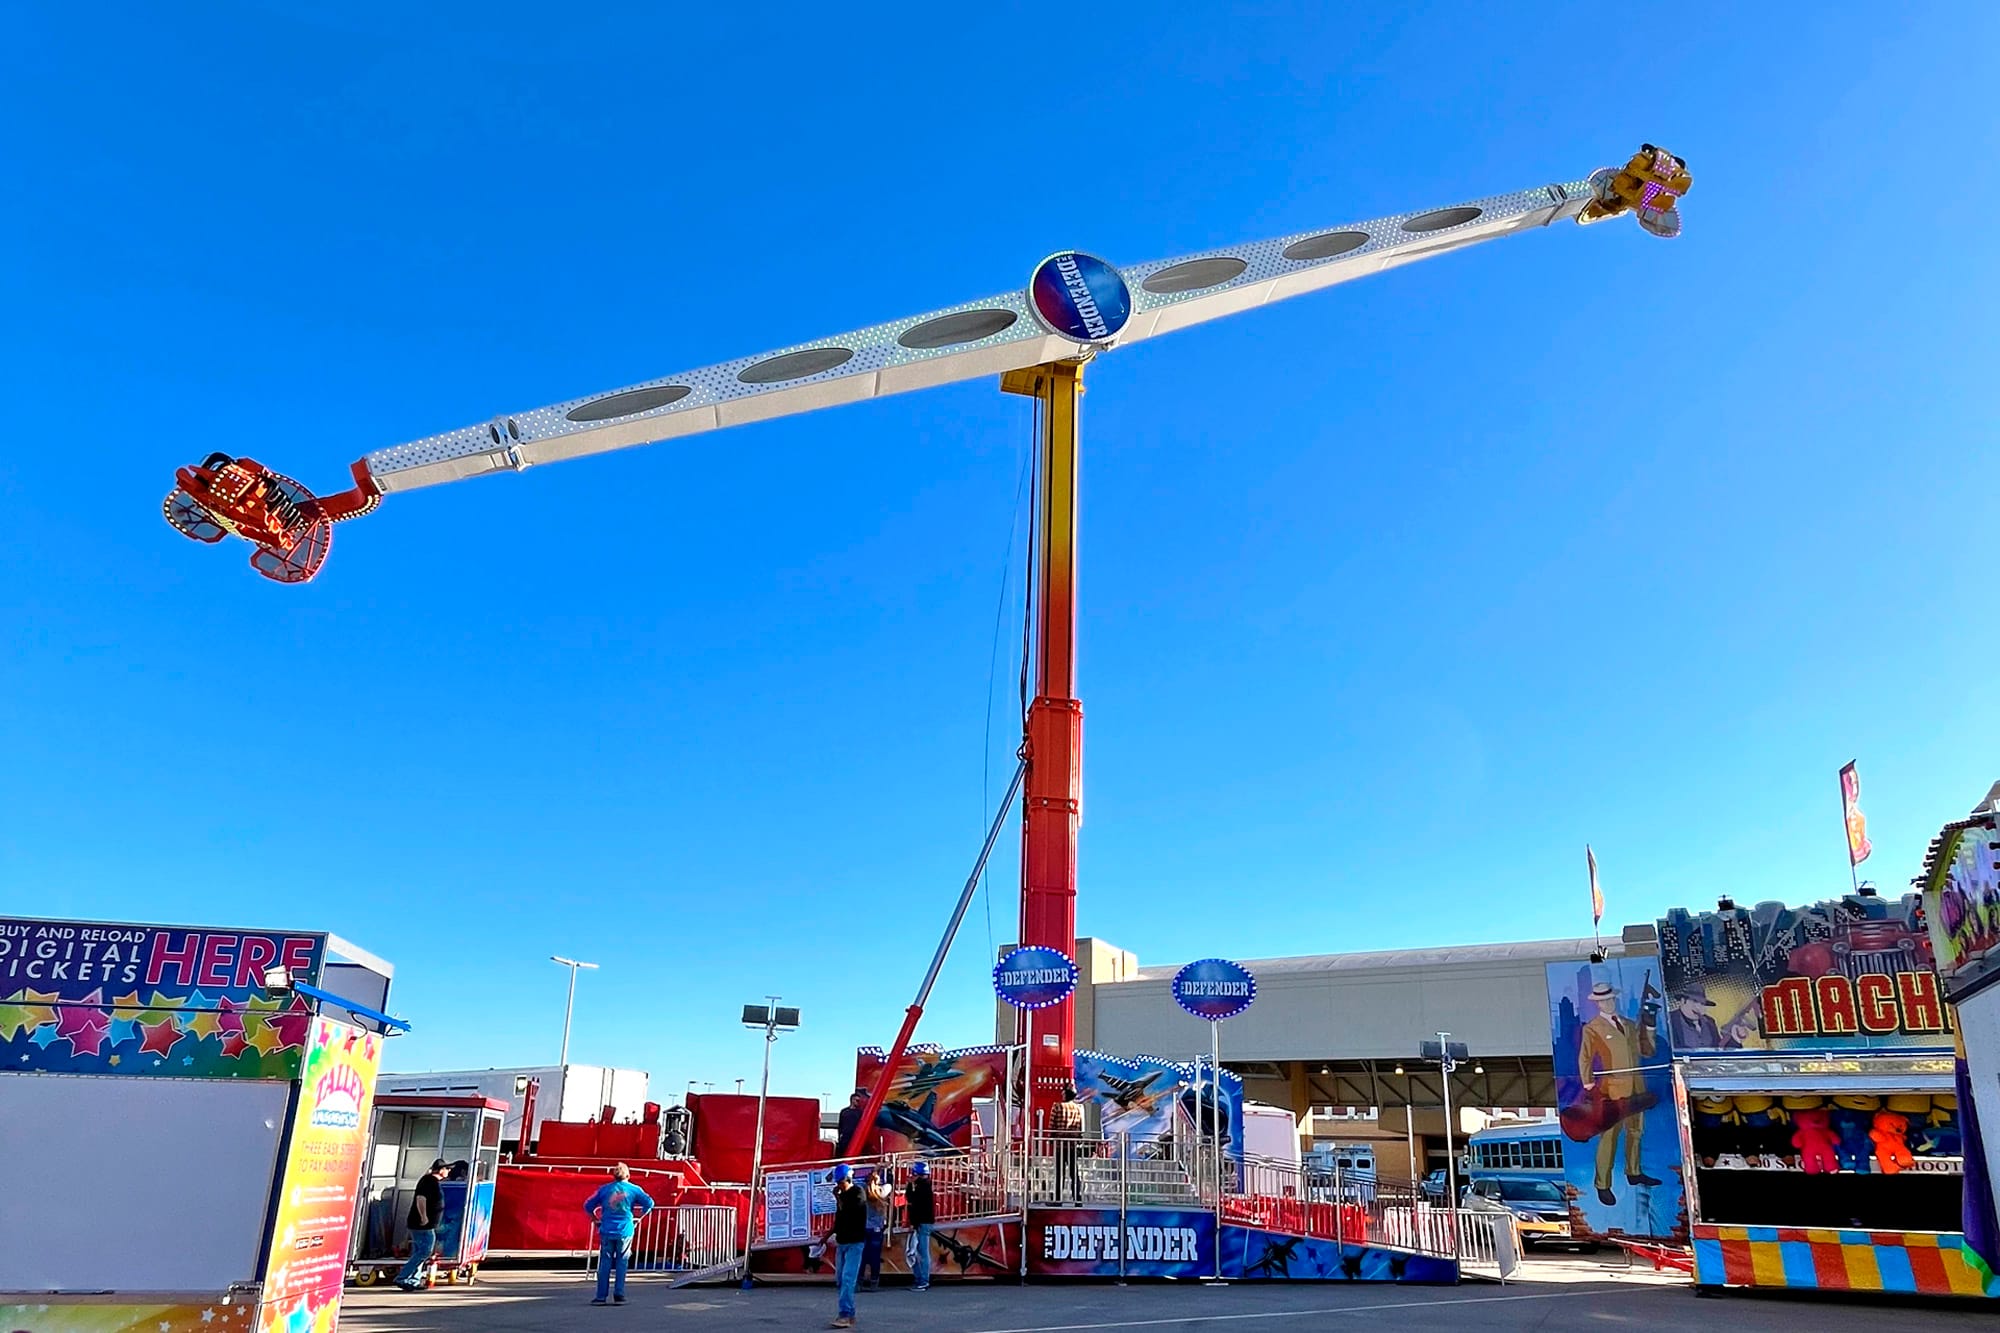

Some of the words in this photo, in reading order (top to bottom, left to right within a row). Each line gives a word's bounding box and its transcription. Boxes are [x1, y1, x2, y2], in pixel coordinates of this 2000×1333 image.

[1055, 255, 1073, 263] THE
[1056, 260, 1109, 339] DEFENDER
[0, 925, 31, 937] BUY
[36, 927, 75, 940] AND
[80, 929, 146, 943] RELOAD
[0, 958, 138, 983] ICKETS
[145, 932, 315, 988] HERE
[1004, 967, 1070, 986] DEFENDER
[1184, 981, 1249, 996] DEFENDER
[1761, 971, 1955, 1034] MACH
[315, 1063, 365, 1112] TALLEY
[1044, 1225, 1053, 1259] THE
[1053, 1225, 1198, 1261] DEFENDER
